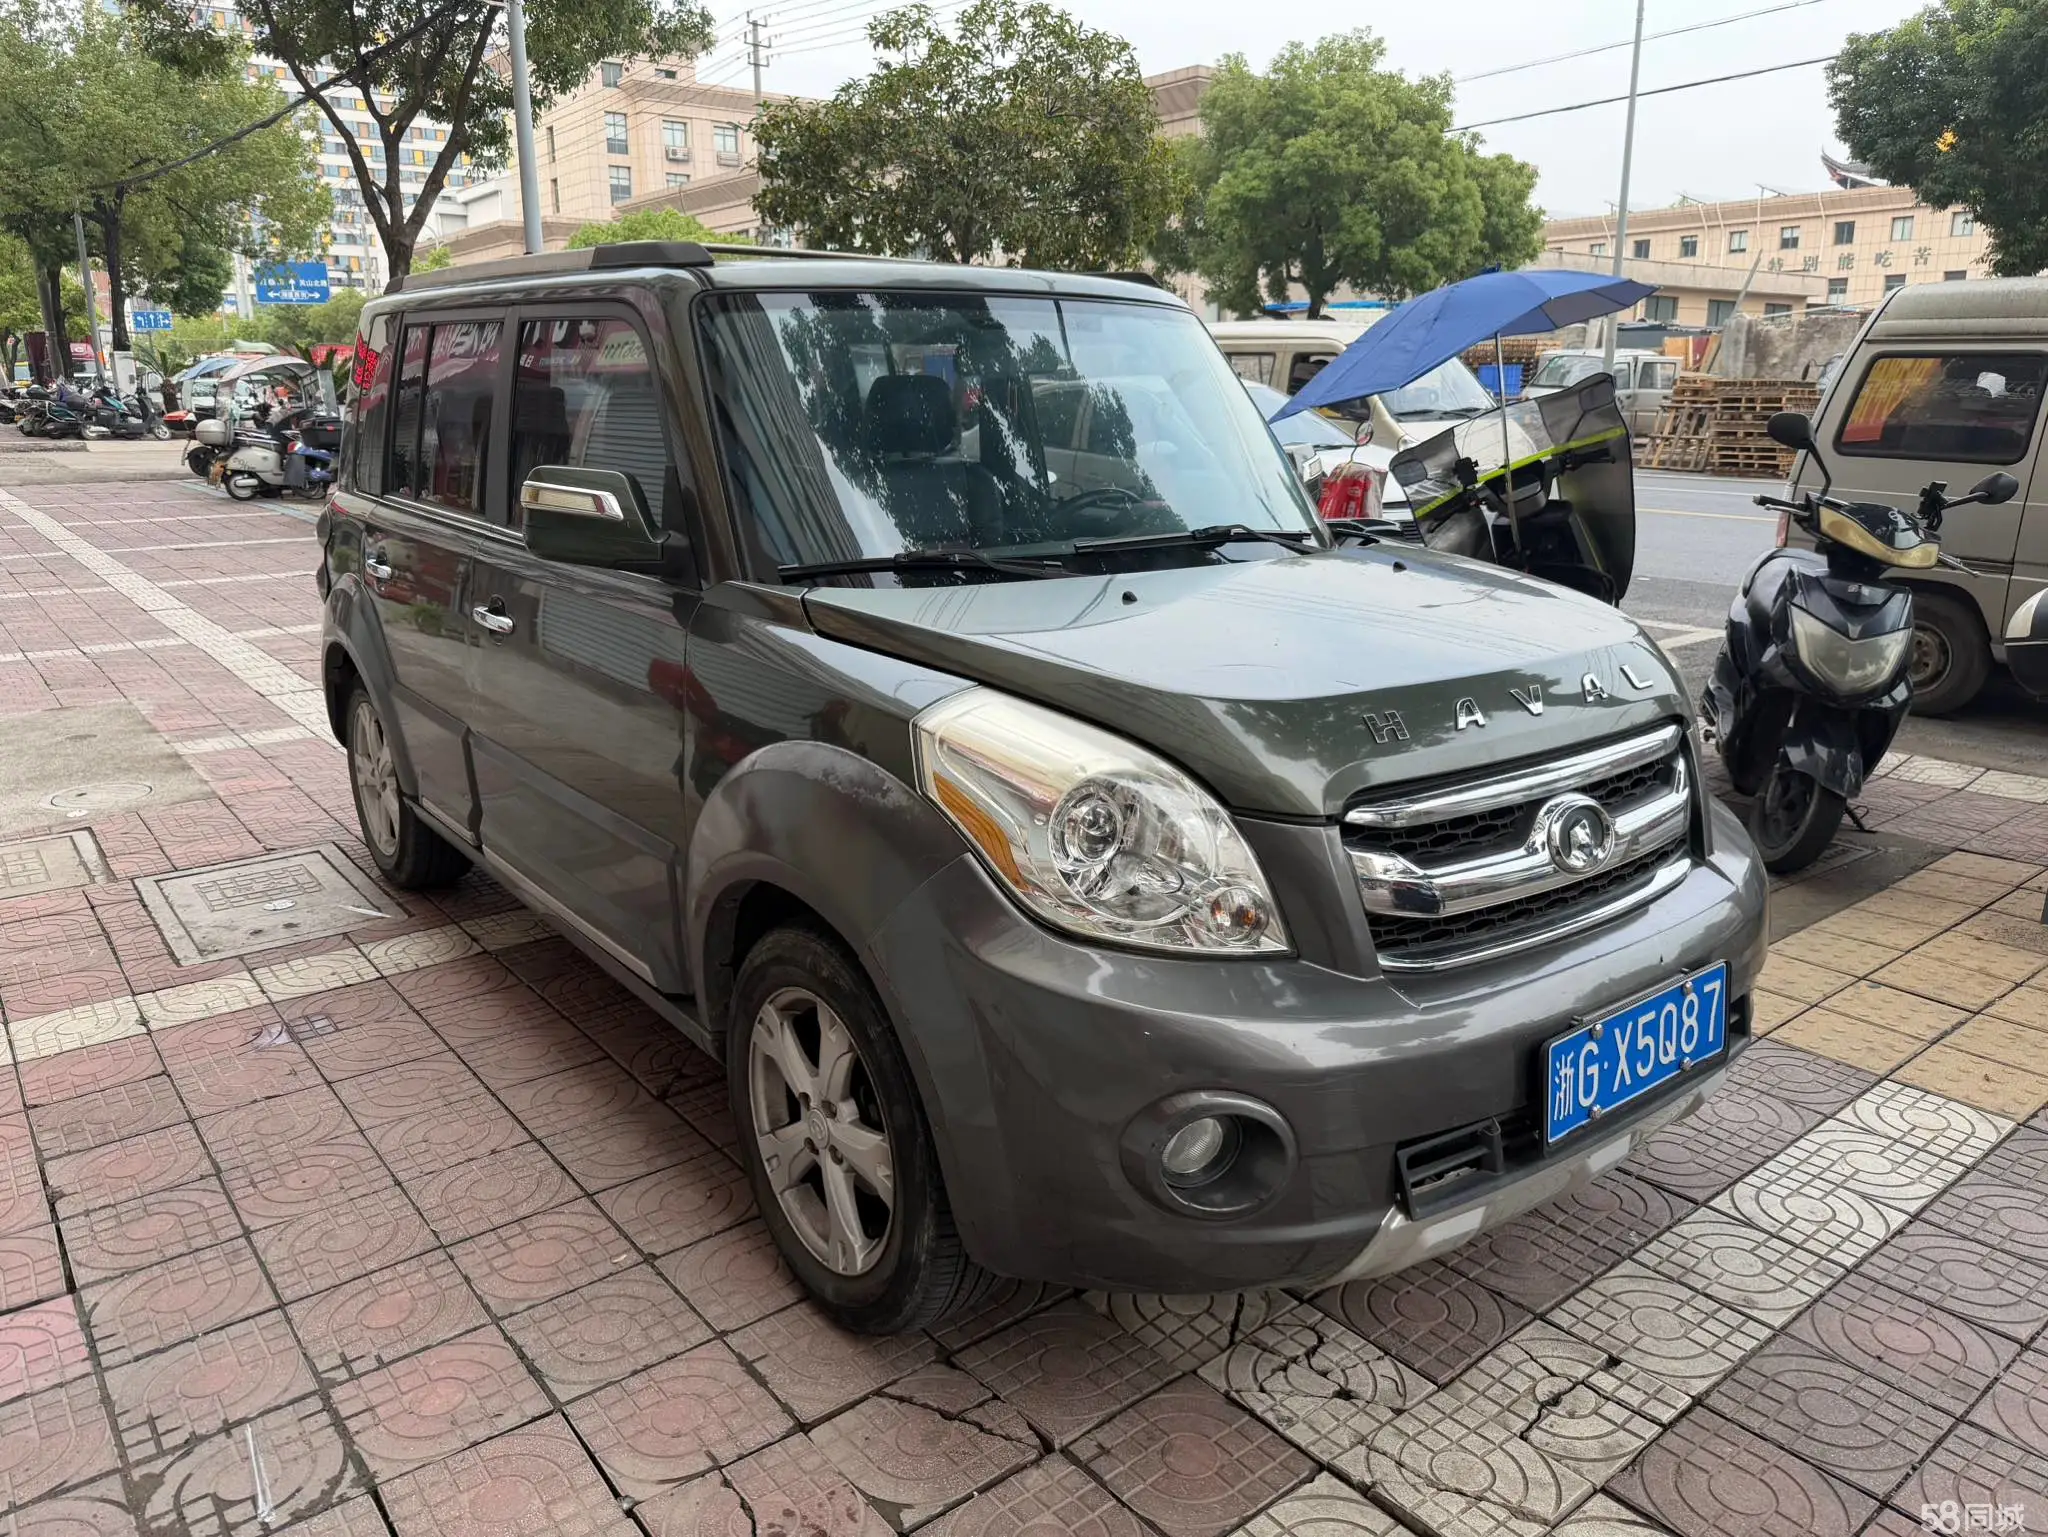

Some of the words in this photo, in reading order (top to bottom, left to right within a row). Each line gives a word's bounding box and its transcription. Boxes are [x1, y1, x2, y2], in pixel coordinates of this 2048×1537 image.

[1768, 246, 1932, 272] 特别能吃苦
[1363, 664, 1654, 744] HAVAL
